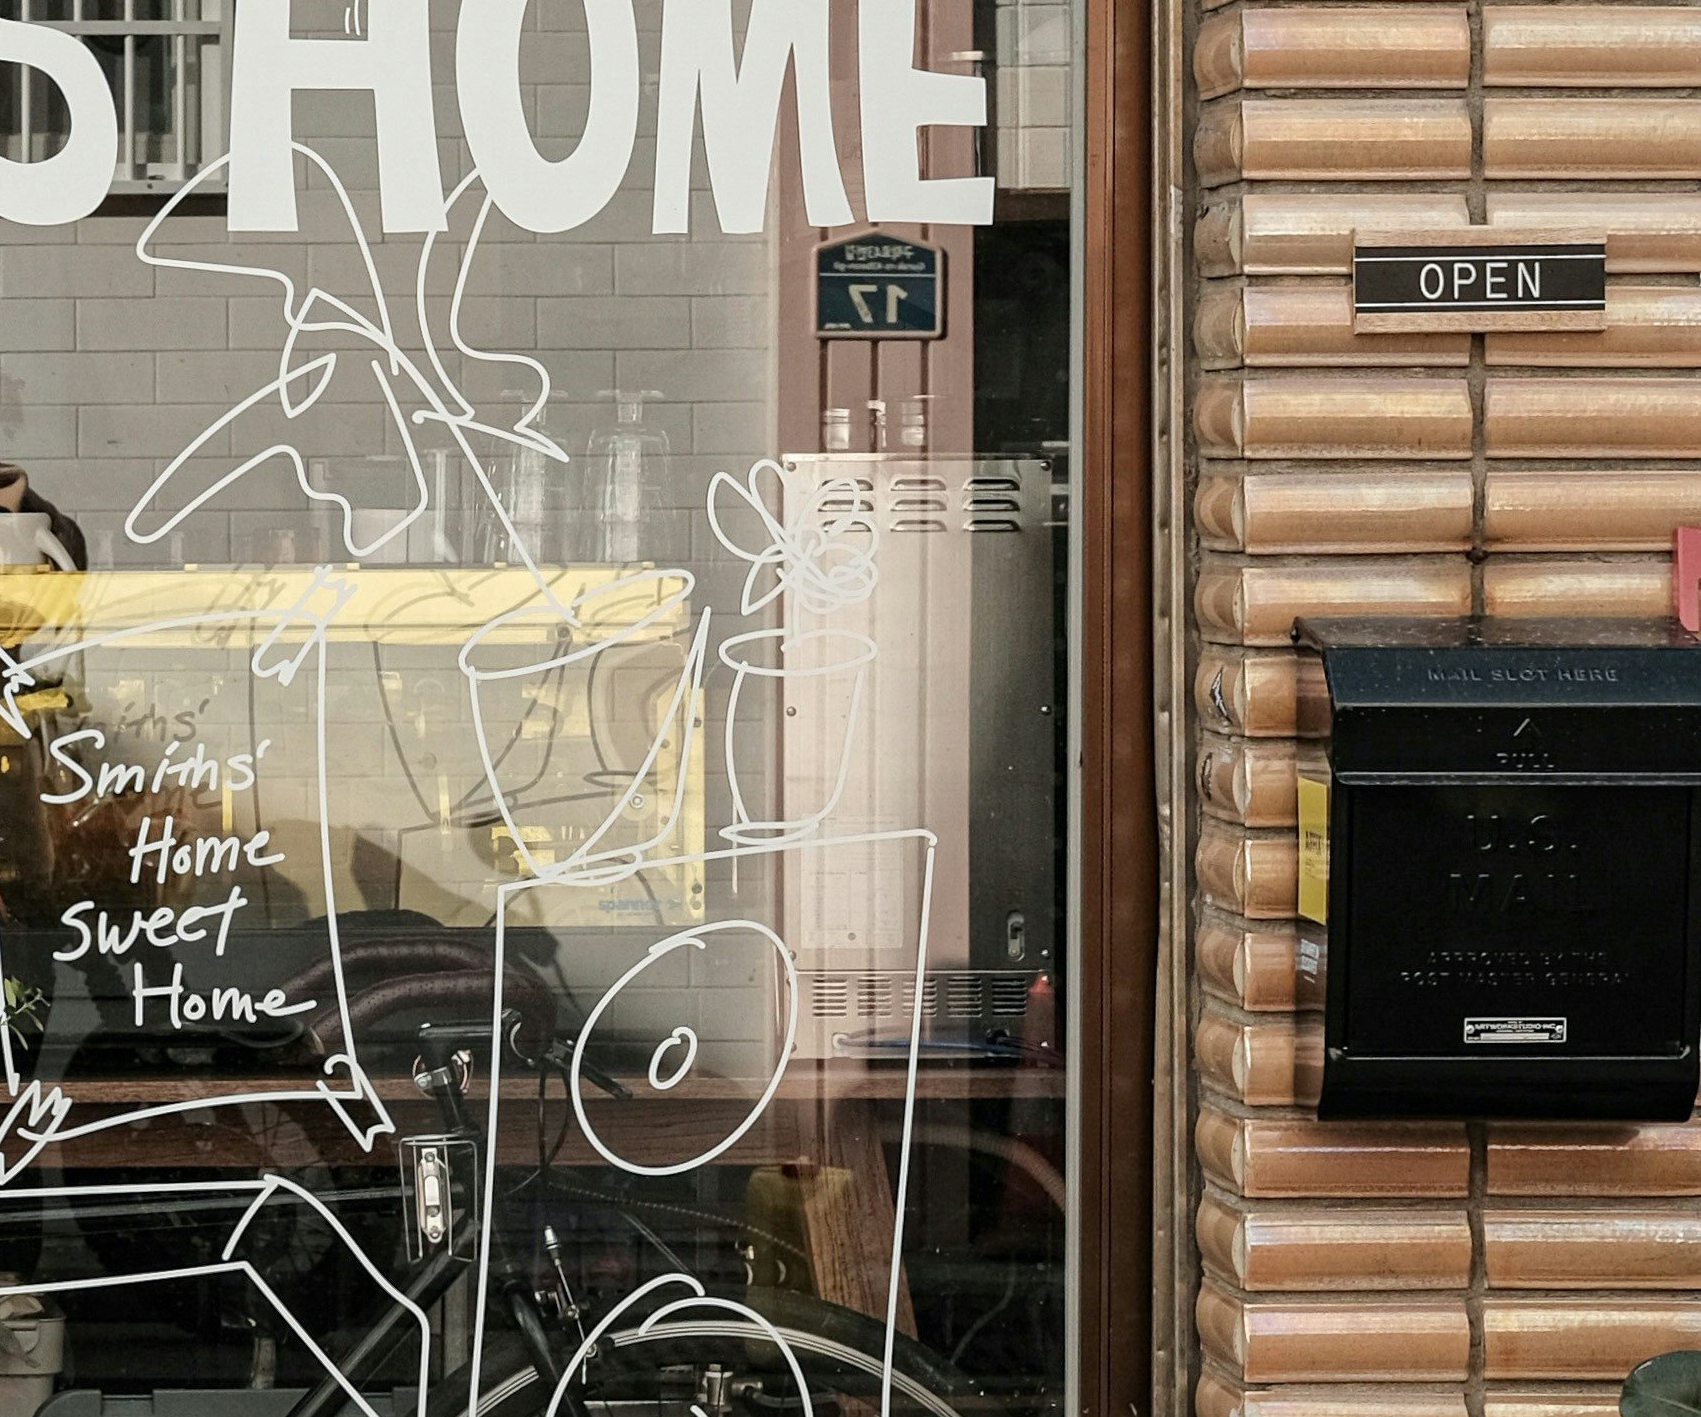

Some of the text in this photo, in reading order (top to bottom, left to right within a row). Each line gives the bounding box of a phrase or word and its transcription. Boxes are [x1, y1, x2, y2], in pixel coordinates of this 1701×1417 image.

[1419, 262, 1541, 300] OPEN
[1557, 668, 1619, 682] HERE
[127, 815, 286, 884] Home
[131, 962, 318, 1029] Home
